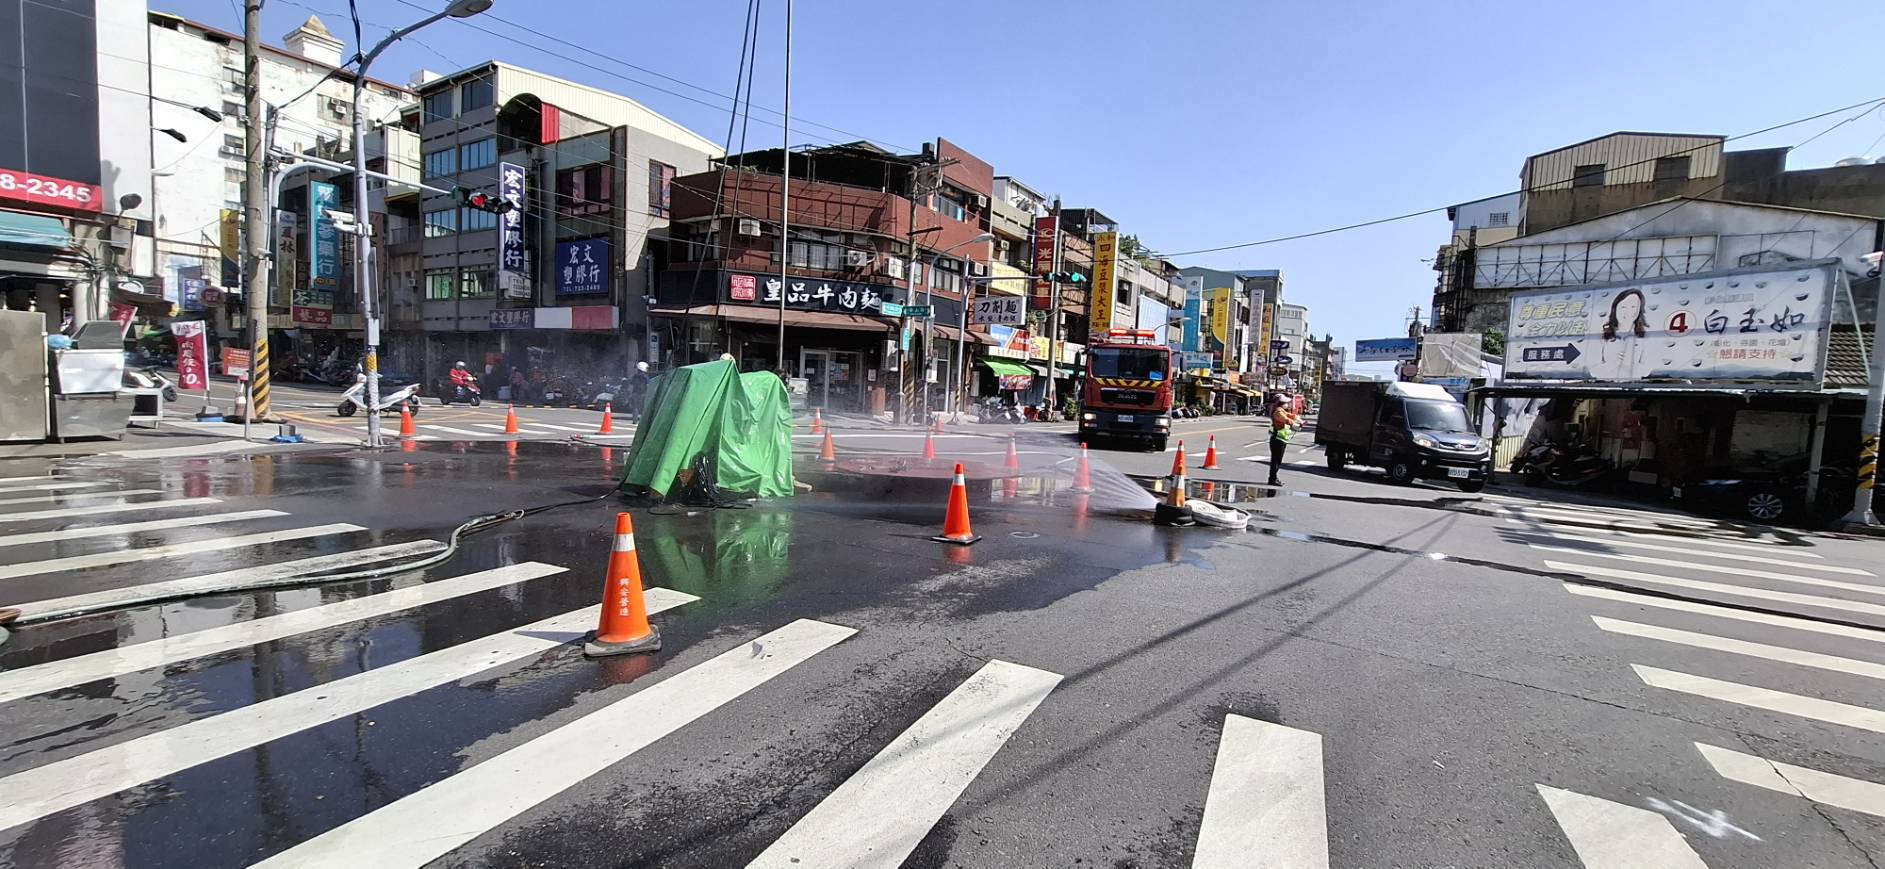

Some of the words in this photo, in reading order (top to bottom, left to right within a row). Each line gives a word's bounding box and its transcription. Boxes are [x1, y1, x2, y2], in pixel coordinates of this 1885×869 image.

[0, 173, 92, 203] 8-2345
[504, 169, 523, 268] 宏文塑膠行
[569, 245, 594, 265] 宏文
[563, 264, 601, 286] 塑膠行
[764, 278, 882, 313] 皇品牛肉麵
[1520, 301, 1586, 320] 尊重民意
[1704, 304, 1805, 334] 白玉如
[1669, 312, 1688, 333] 4
[1528, 349, 1564, 360] 服務處
[1719, 349, 1776, 360] 懇請支持
